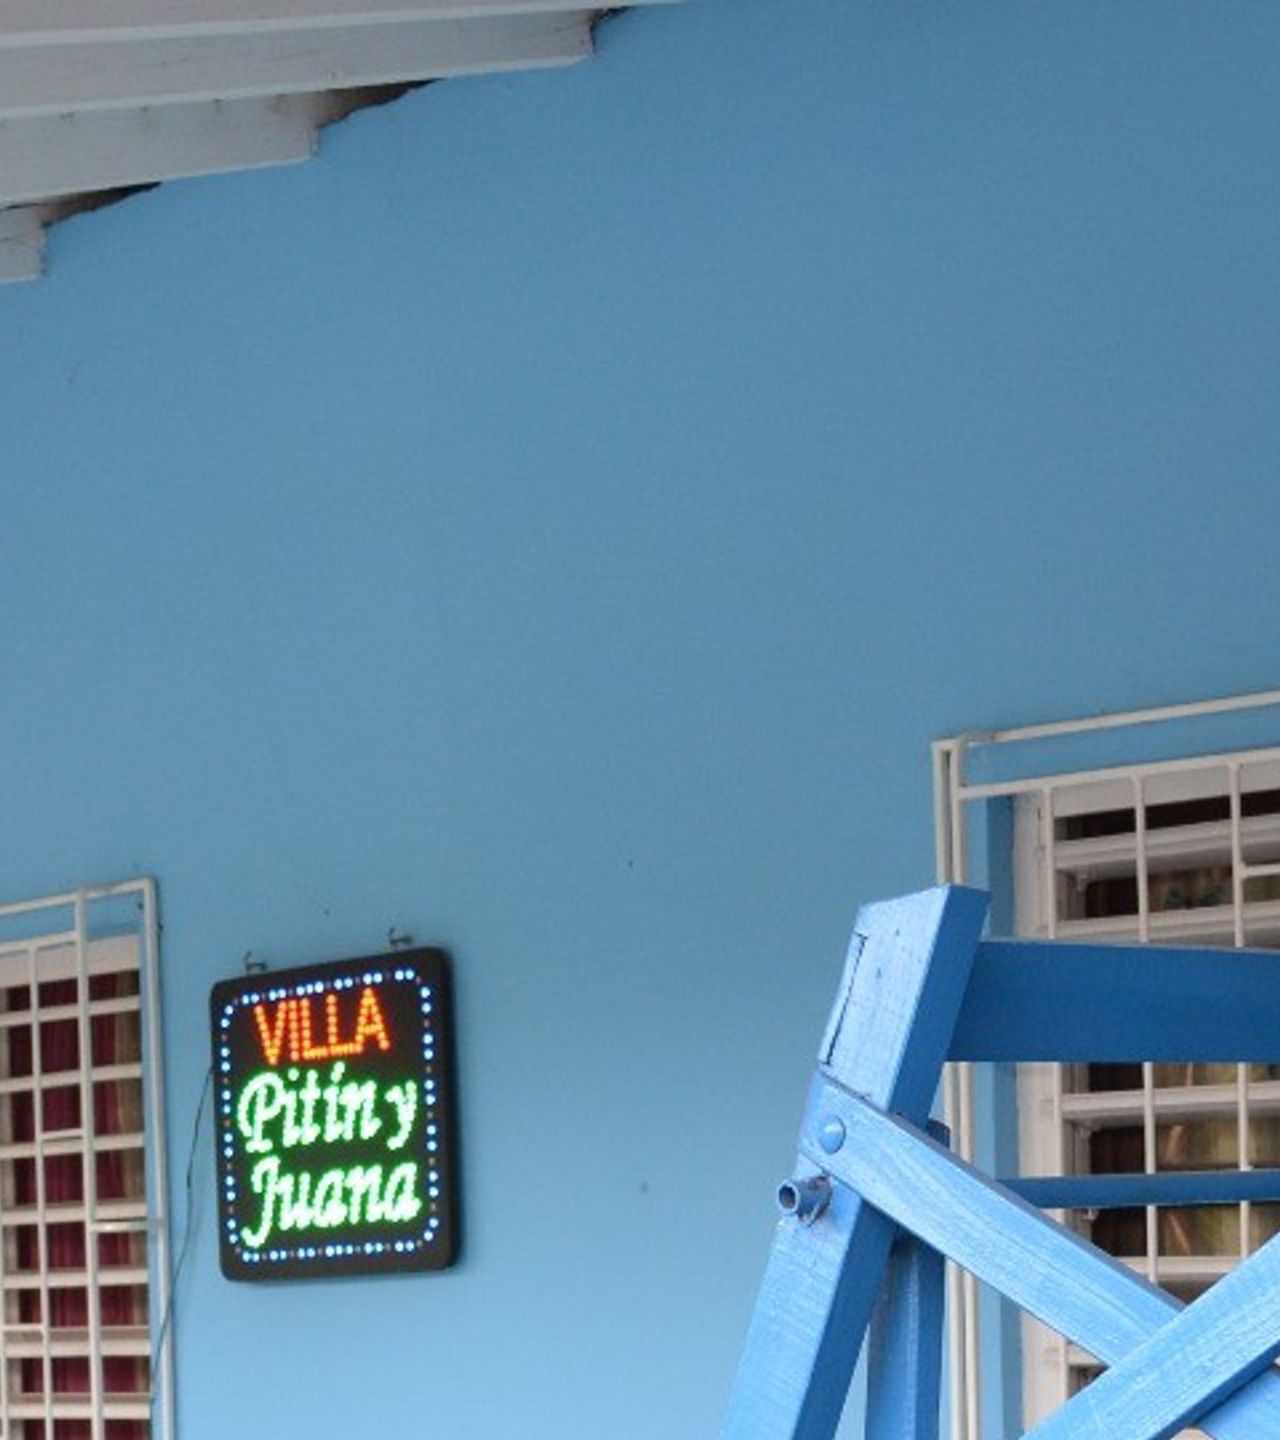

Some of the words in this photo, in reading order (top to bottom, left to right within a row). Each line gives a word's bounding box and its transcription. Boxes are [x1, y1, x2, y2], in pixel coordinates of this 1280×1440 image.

[254, 987, 390, 1064] VILLA
[383, 1079, 418, 1150] y
[239, 1154, 422, 1248] Juana
